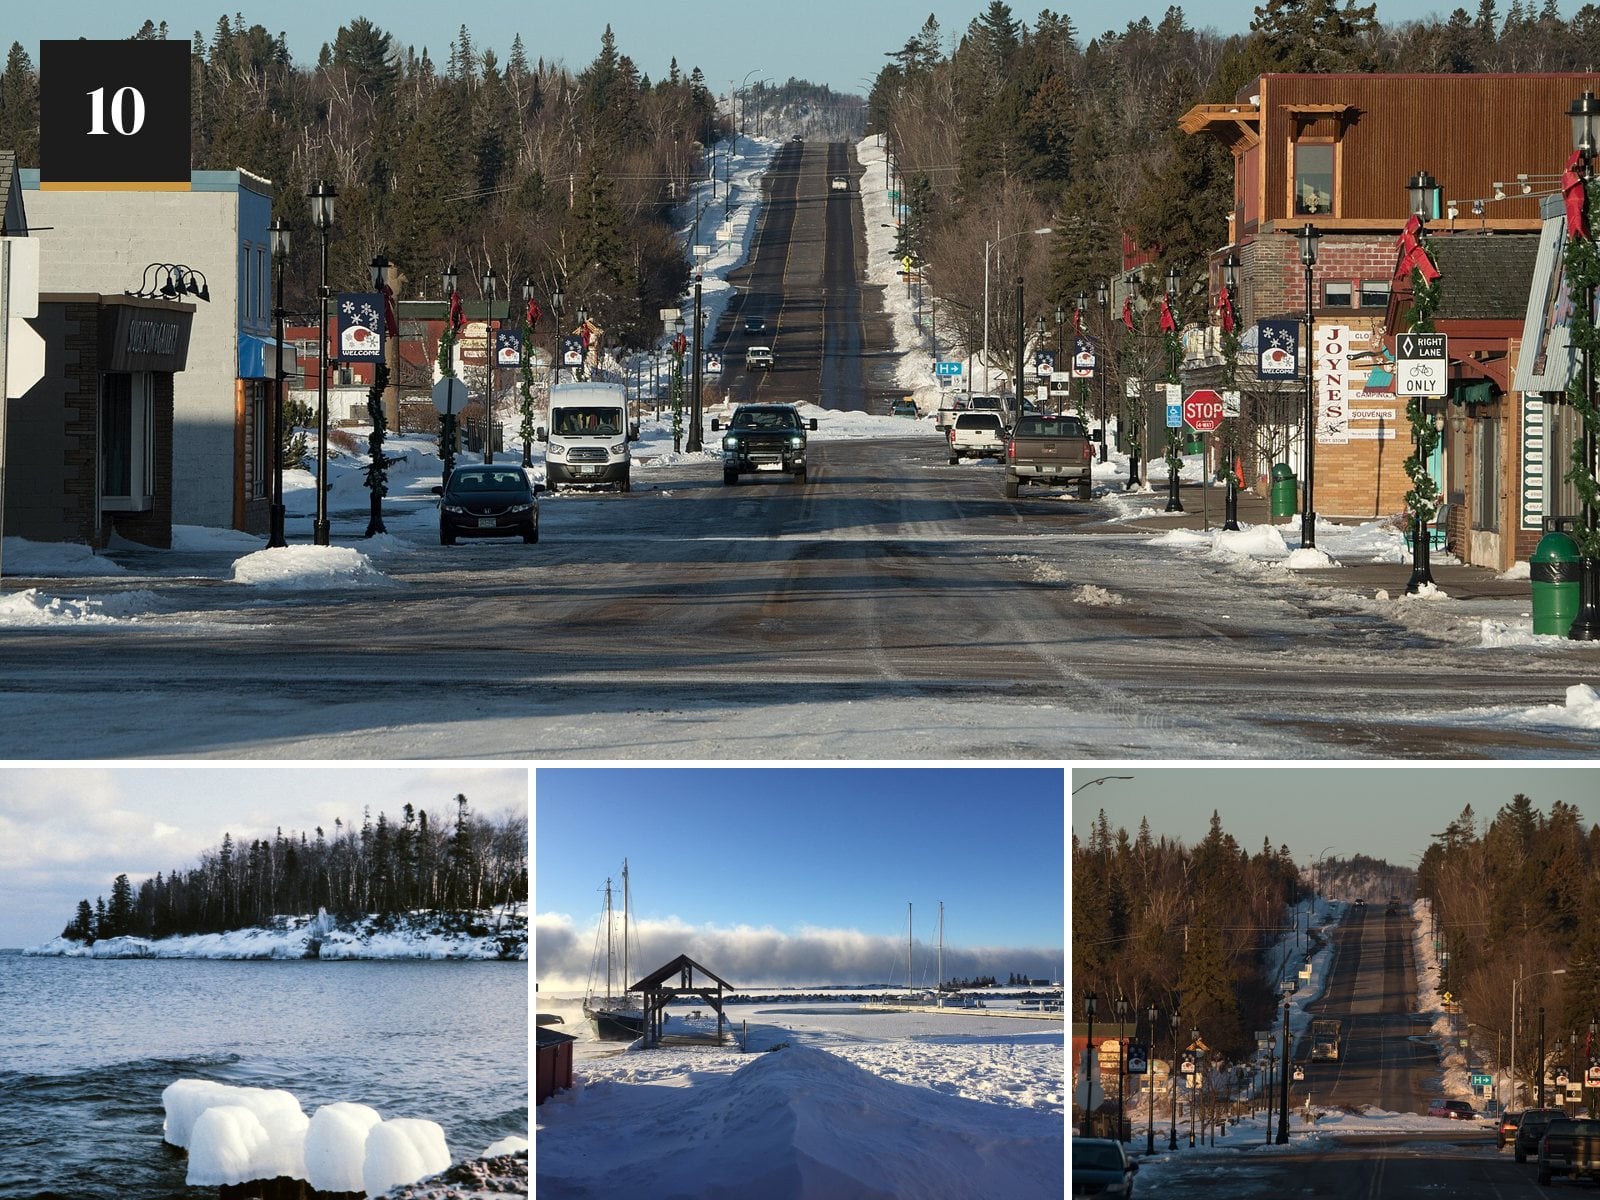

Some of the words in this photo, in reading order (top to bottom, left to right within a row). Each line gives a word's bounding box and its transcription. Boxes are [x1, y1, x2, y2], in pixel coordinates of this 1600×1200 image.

[1326, 329, 1342, 418] JOYNES
[1407, 380, 1436, 391] ONLY
[1187, 403, 1222, 418] STOP
